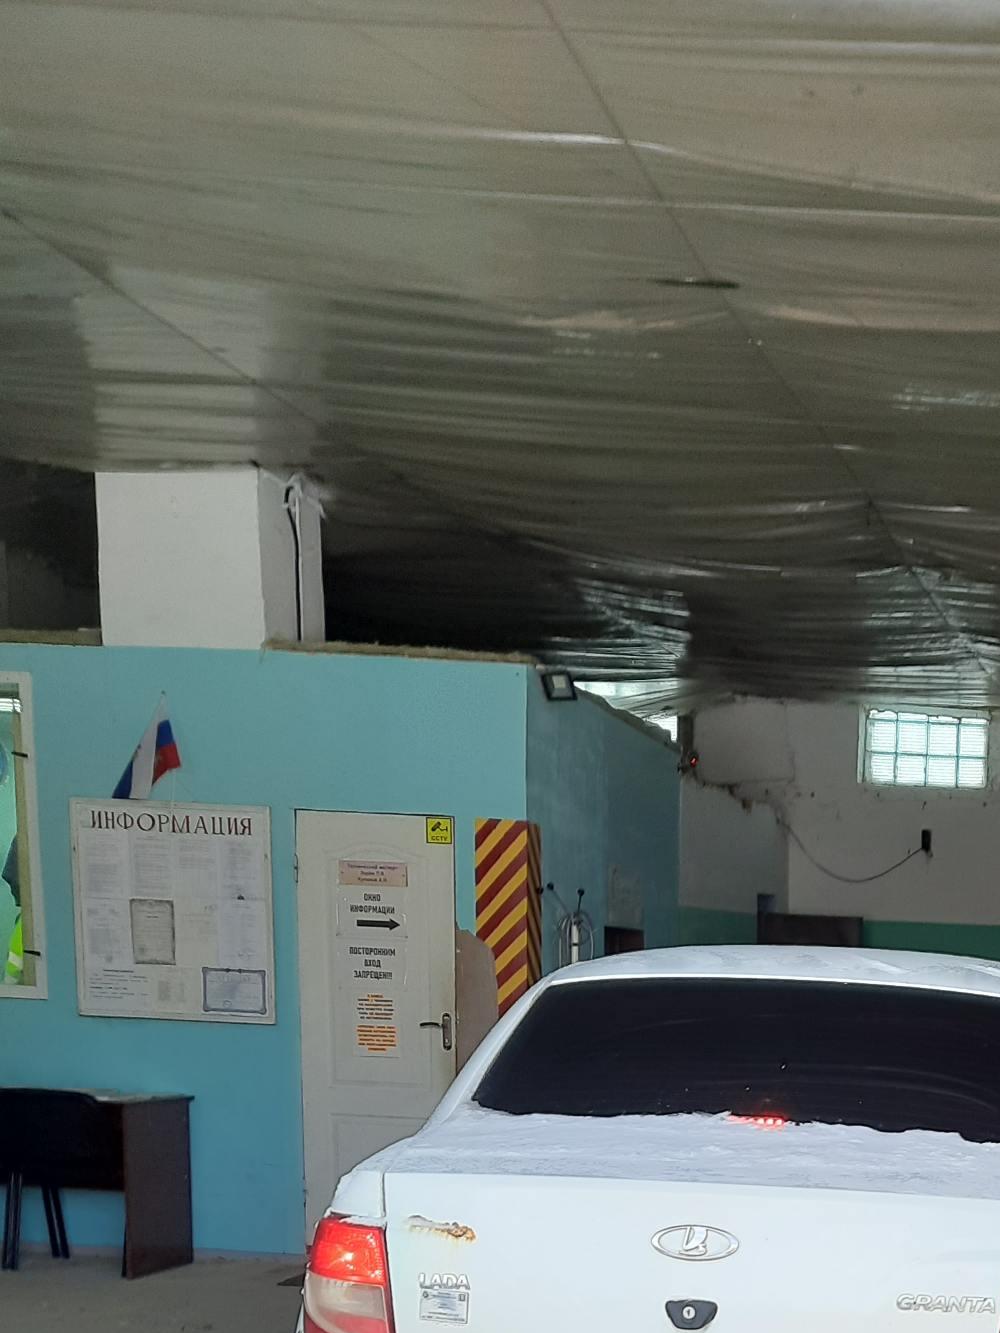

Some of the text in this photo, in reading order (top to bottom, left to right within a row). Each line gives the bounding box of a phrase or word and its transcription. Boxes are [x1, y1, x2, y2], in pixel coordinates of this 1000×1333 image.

[91, 810, 253, 836] ИНФОРМАЦИЯ
[363, 893, 381, 902] ОКНО
[350, 904, 395, 915] ИНФОРМАЦИИ
[349, 946, 396, 957] ПОСТОРОННИМ
[364, 959, 381, 968] ВХОД
[418, 1272, 471, 1290] LADA
[896, 1293, 996, 1314] GRANTA
